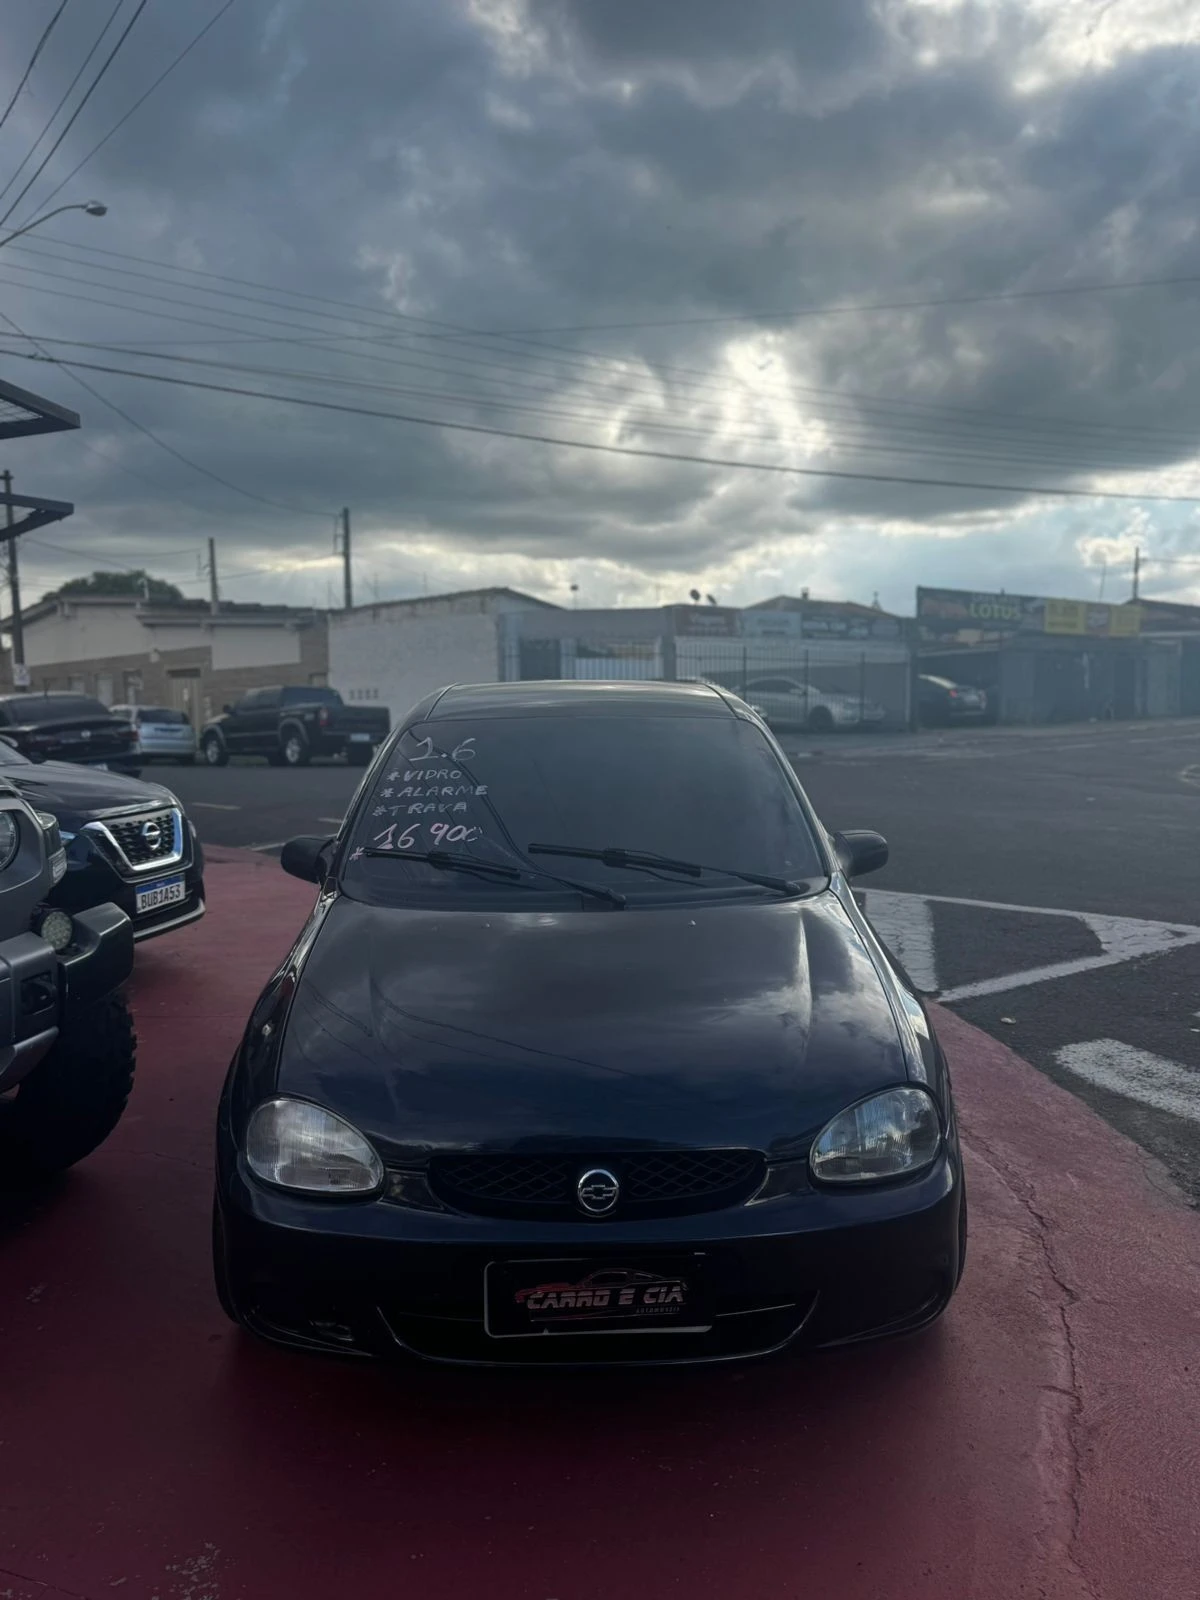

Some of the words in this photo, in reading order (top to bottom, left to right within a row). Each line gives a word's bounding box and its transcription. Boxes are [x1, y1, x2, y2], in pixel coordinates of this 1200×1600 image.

[408, 737, 476, 761] 1.6
[373, 823, 421, 849] 16
[141, 885, 180, 908] BUB1A53
[527, 1289, 611, 1310] CARRO
[618, 1287, 635, 1305] E
[643, 1285, 684, 1304] CIA
